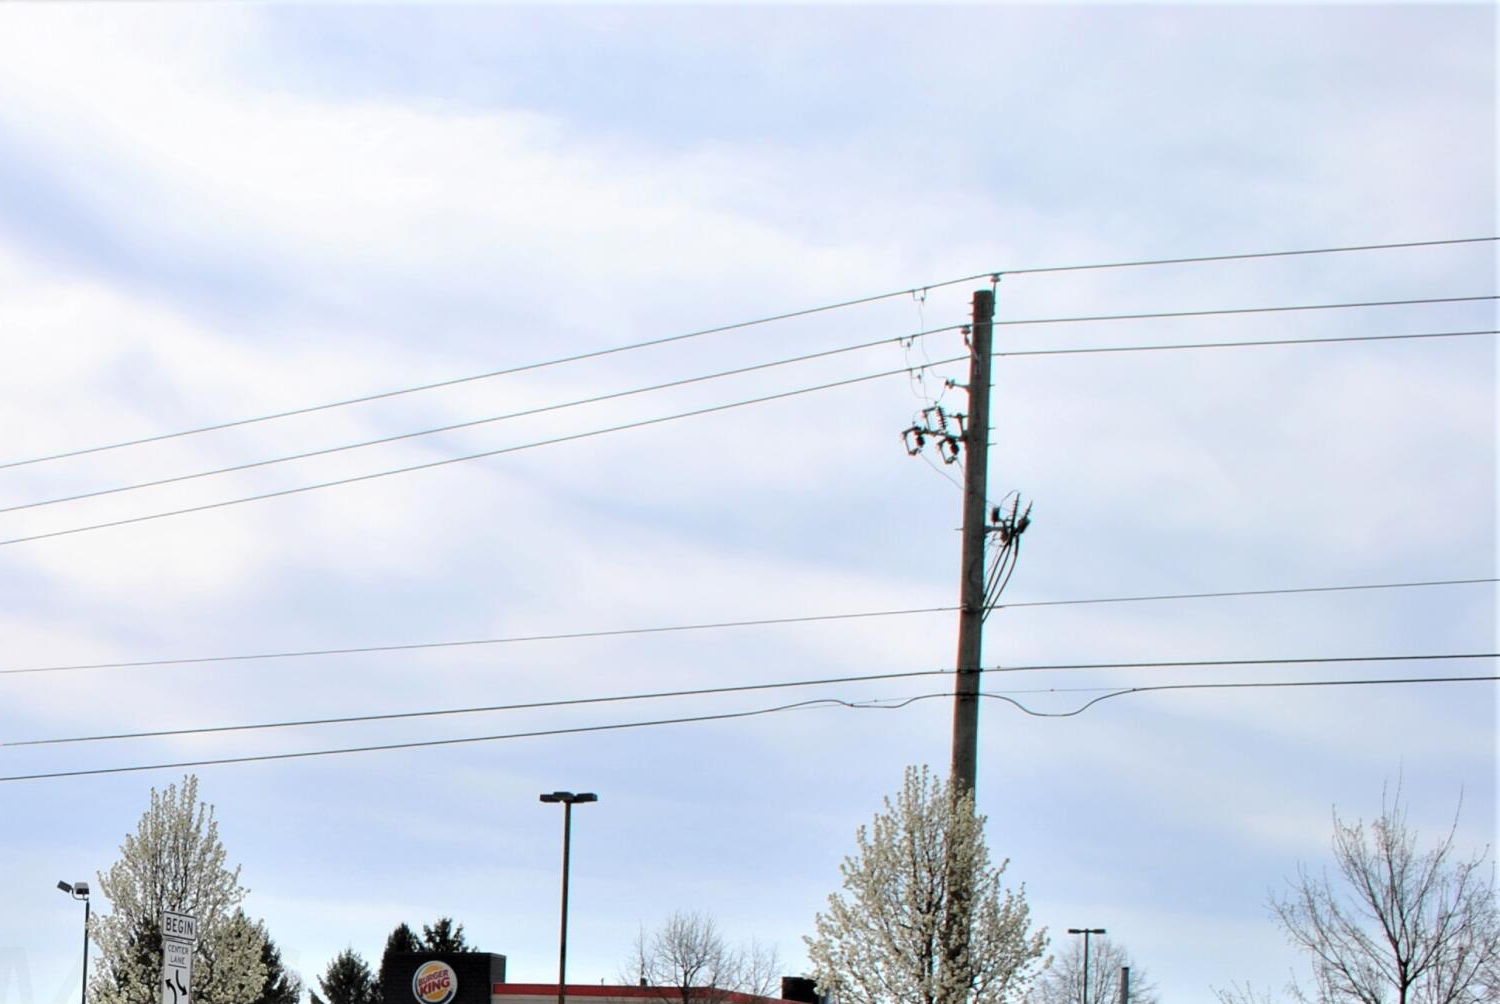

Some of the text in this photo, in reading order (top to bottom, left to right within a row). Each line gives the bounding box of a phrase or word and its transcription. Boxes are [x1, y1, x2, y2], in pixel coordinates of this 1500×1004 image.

[165, 917, 194, 935] BEGIN
[167, 944, 189, 955] CENTER
[170, 956, 186, 965] LANE
[419, 969, 449, 987] BURGER
[419, 976, 450, 998] KING
